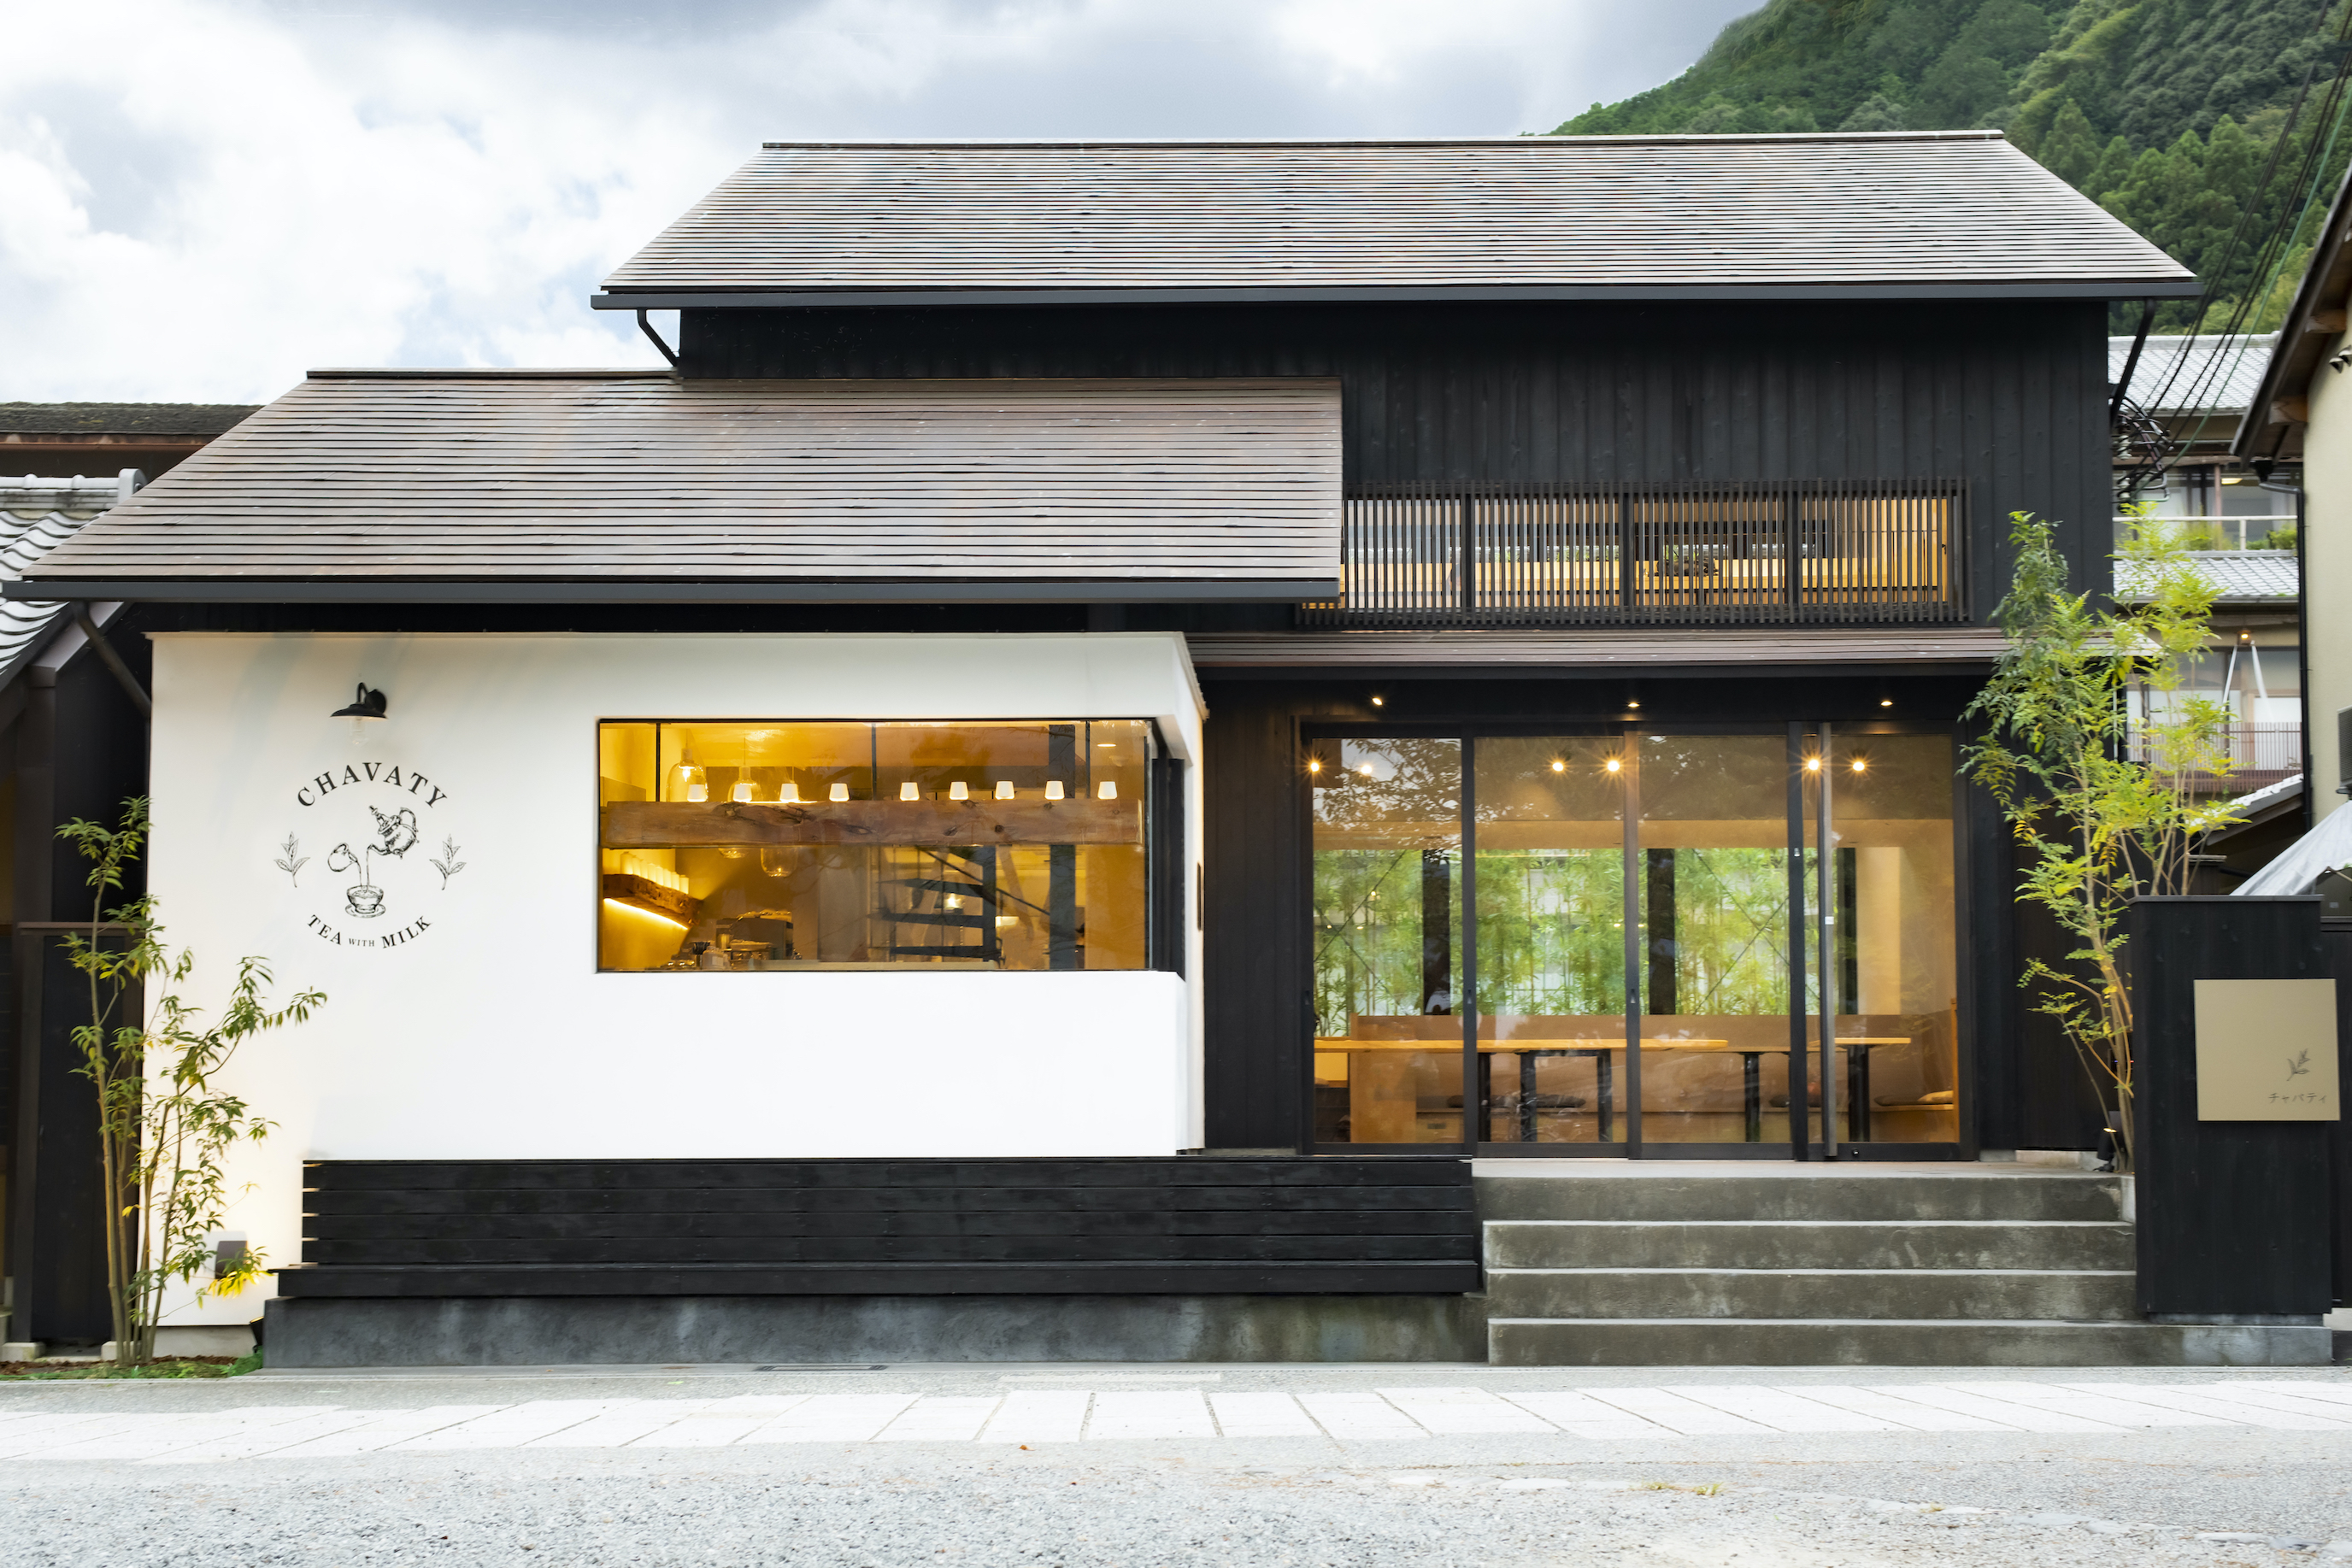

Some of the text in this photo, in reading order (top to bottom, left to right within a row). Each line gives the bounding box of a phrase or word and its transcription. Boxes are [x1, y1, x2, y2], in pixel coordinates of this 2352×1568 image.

[297, 762, 447, 808] CHAVATY
[307, 913, 432, 949] TEA WITH MILK
